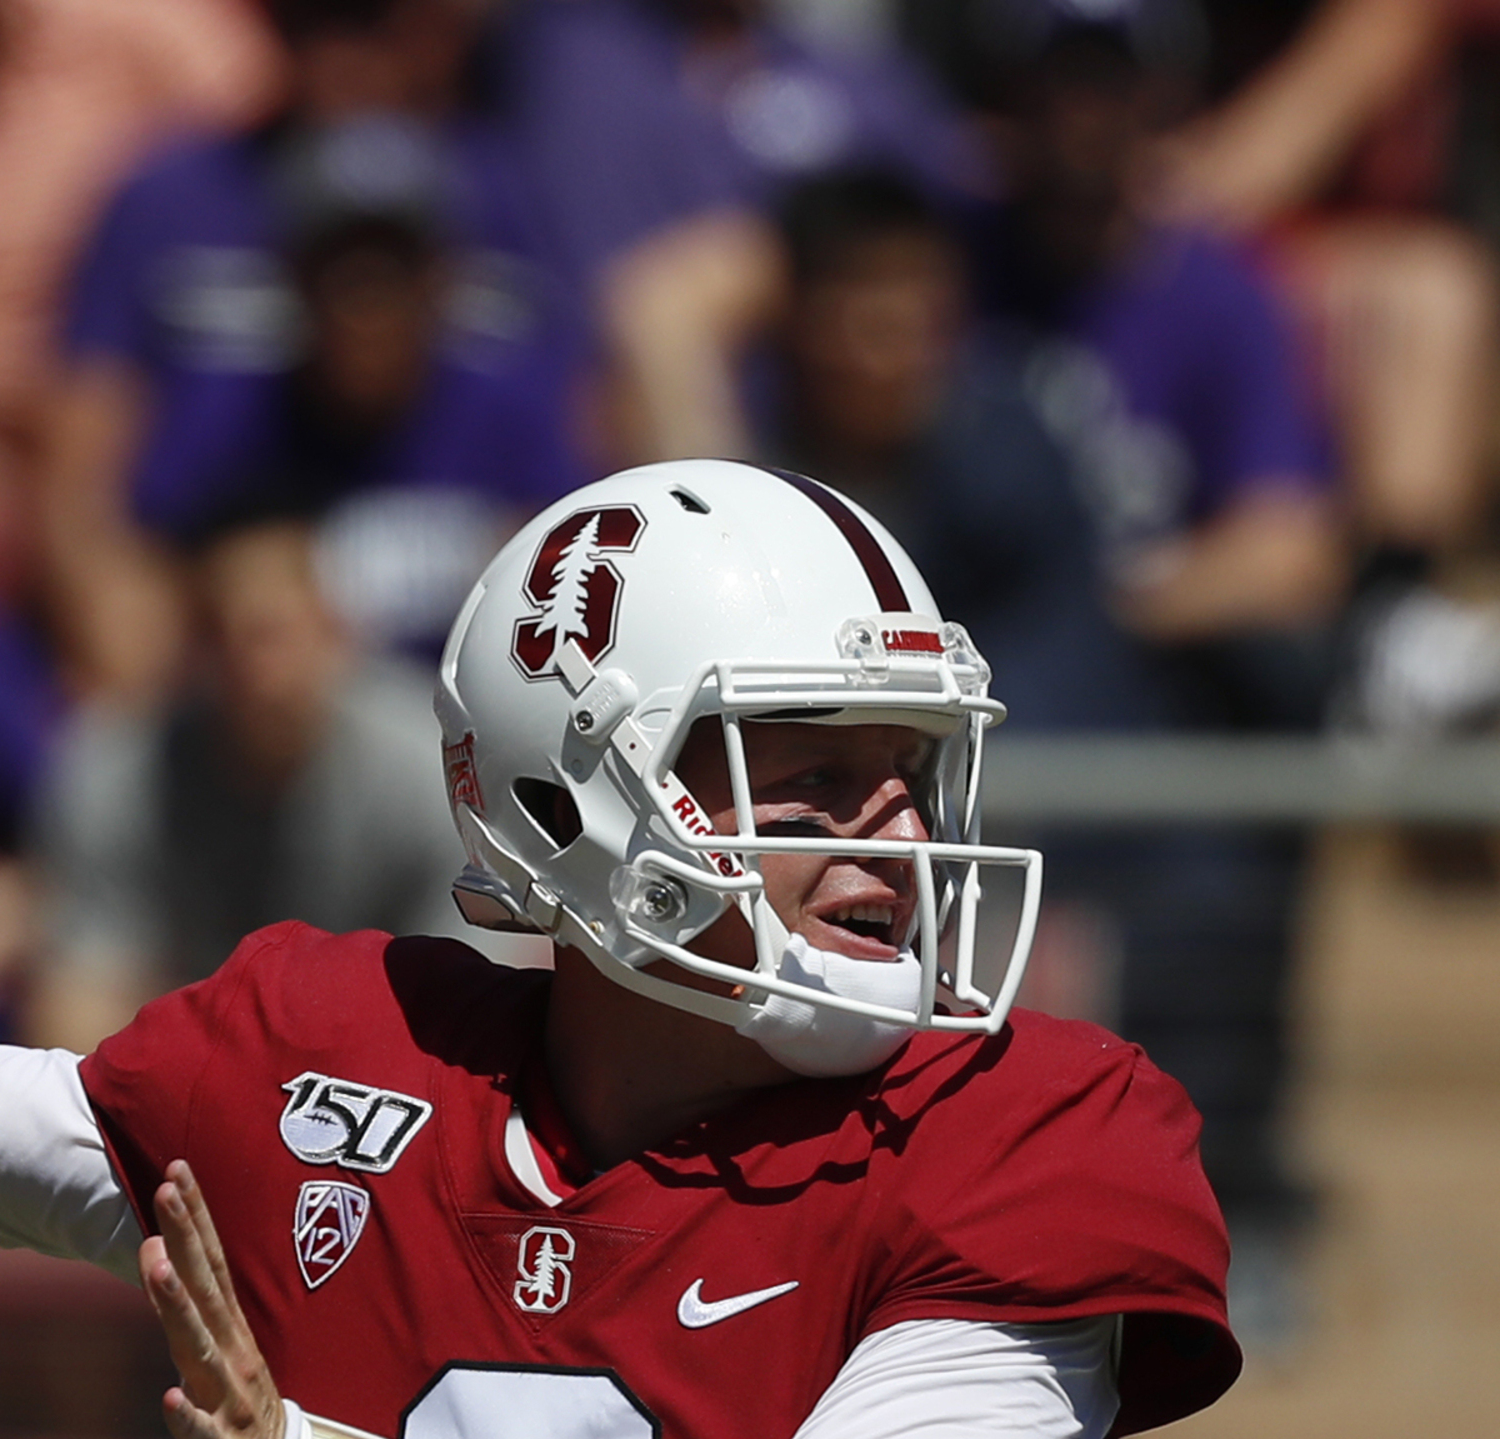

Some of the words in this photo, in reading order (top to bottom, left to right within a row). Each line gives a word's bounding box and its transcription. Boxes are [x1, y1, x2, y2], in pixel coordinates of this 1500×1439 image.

[281, 1071, 433, 1173] 150
[298, 1185, 365, 1249] PAC
[304, 1227, 341, 1265] 12
